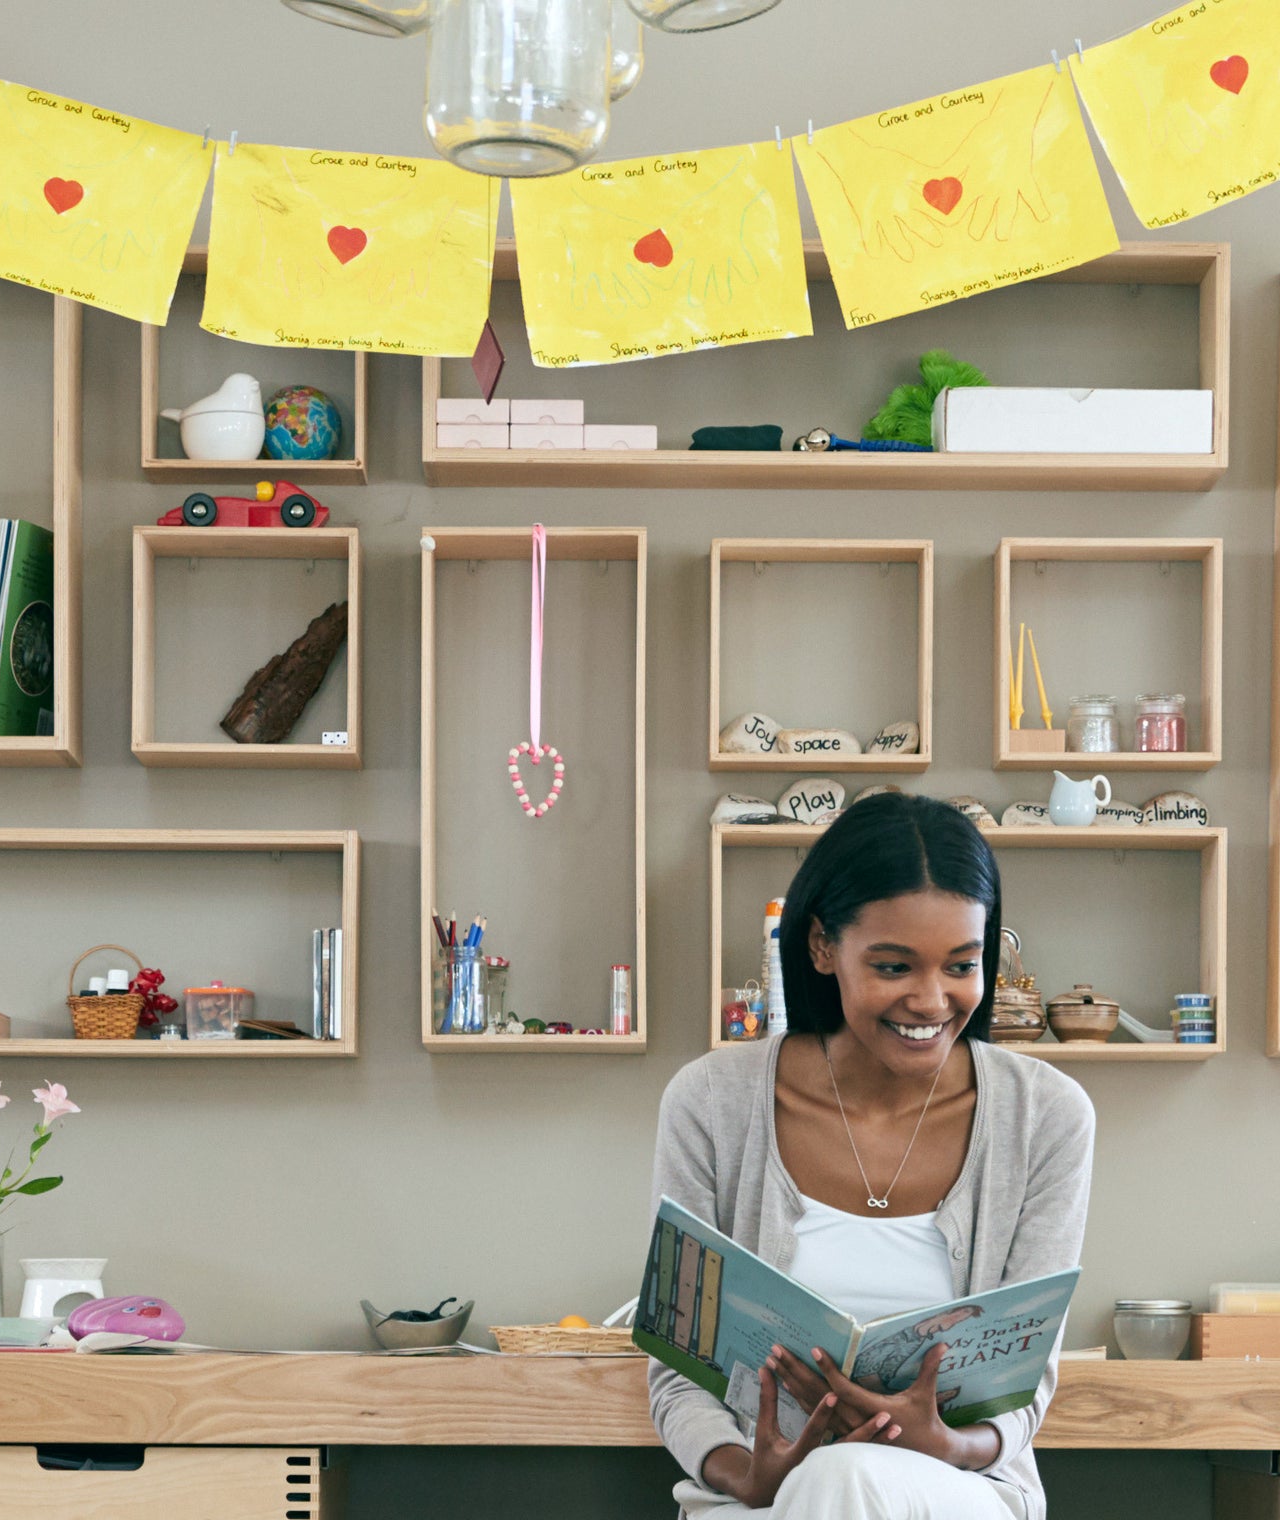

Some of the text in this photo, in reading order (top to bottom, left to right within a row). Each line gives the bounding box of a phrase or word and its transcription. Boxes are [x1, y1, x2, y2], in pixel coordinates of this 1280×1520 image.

[1151, 3, 1207, 35] Grace and
[26, 90, 131, 133] Grace and Courtesy
[877, 91, 984, 128] Grace and Courtesy
[310, 152, 417, 177] Grace and Courtesy
[581, 160, 698, 181] Grace and Courtesy
[850, 307, 876, 326] Finn
[533, 351, 580, 368] Thomas
[744, 716, 777, 752] Joy
[794, 738, 841, 754] space
[789, 790, 836, 819] Play
[1096, 807, 1144, 824] umping
[1146, 801, 1207, 825] climbing
[945, 1337, 975, 1349] My
[982, 1316, 1049, 1340] Daddy
[937, 1331, 1043, 1375] GIANT
